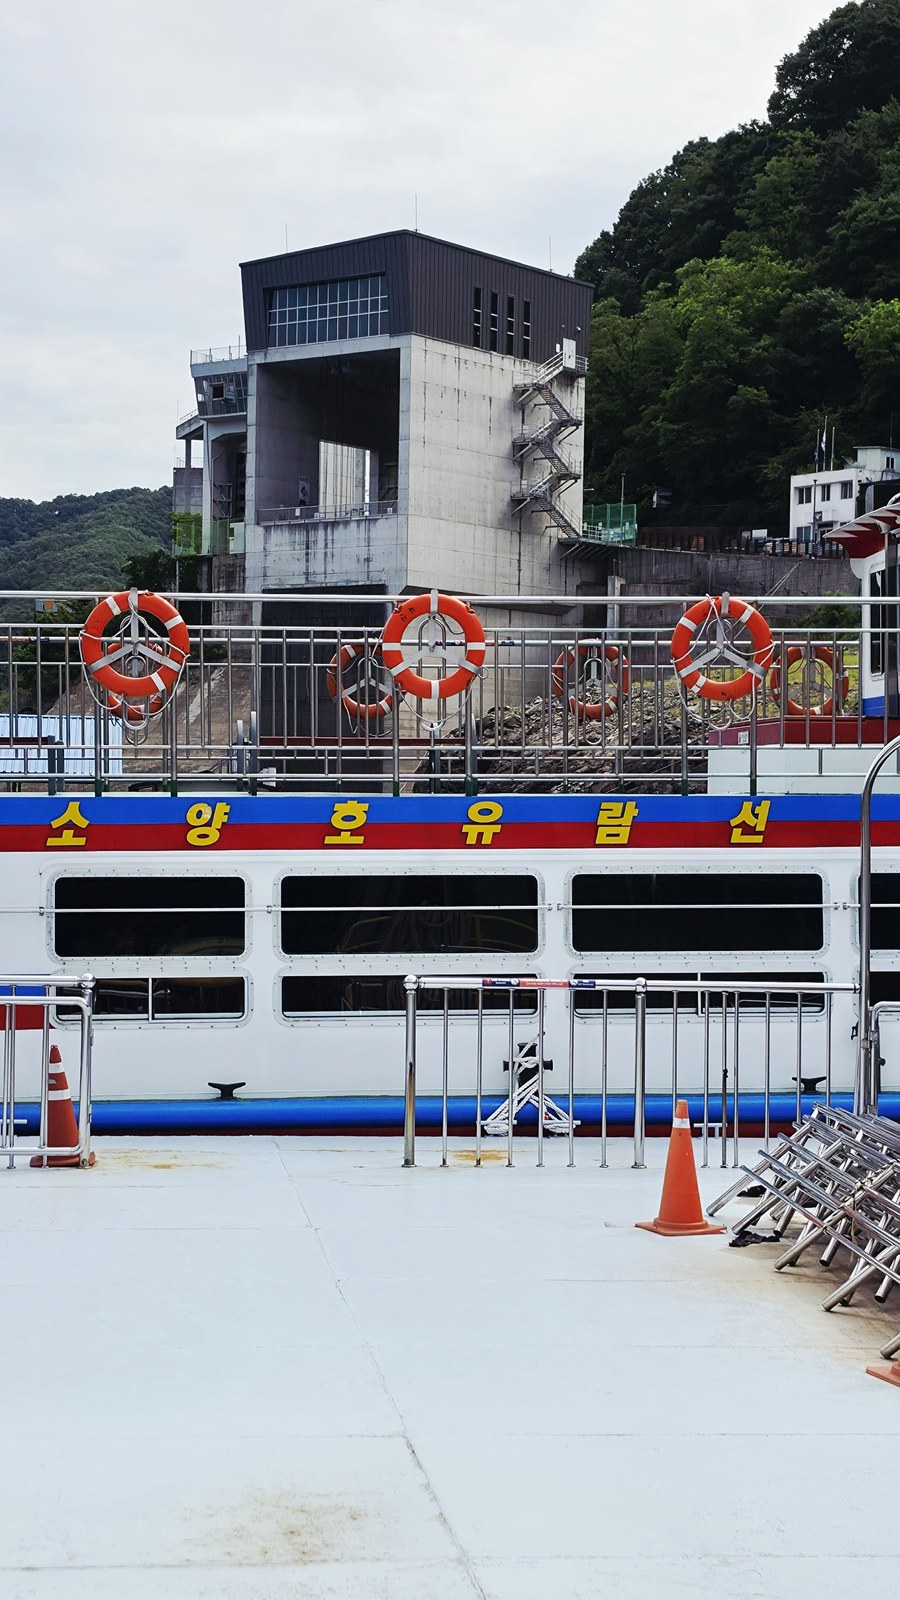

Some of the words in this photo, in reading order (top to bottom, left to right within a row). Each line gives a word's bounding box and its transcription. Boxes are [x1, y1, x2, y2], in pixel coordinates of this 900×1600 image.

[46, 801, 89, 846] 소
[186, 802, 231, 846] 양
[324, 800, 369, 844] 호
[461, 801, 503, 845] 유
[595, 801, 639, 844] 람
[729, 800, 771, 843] 선
